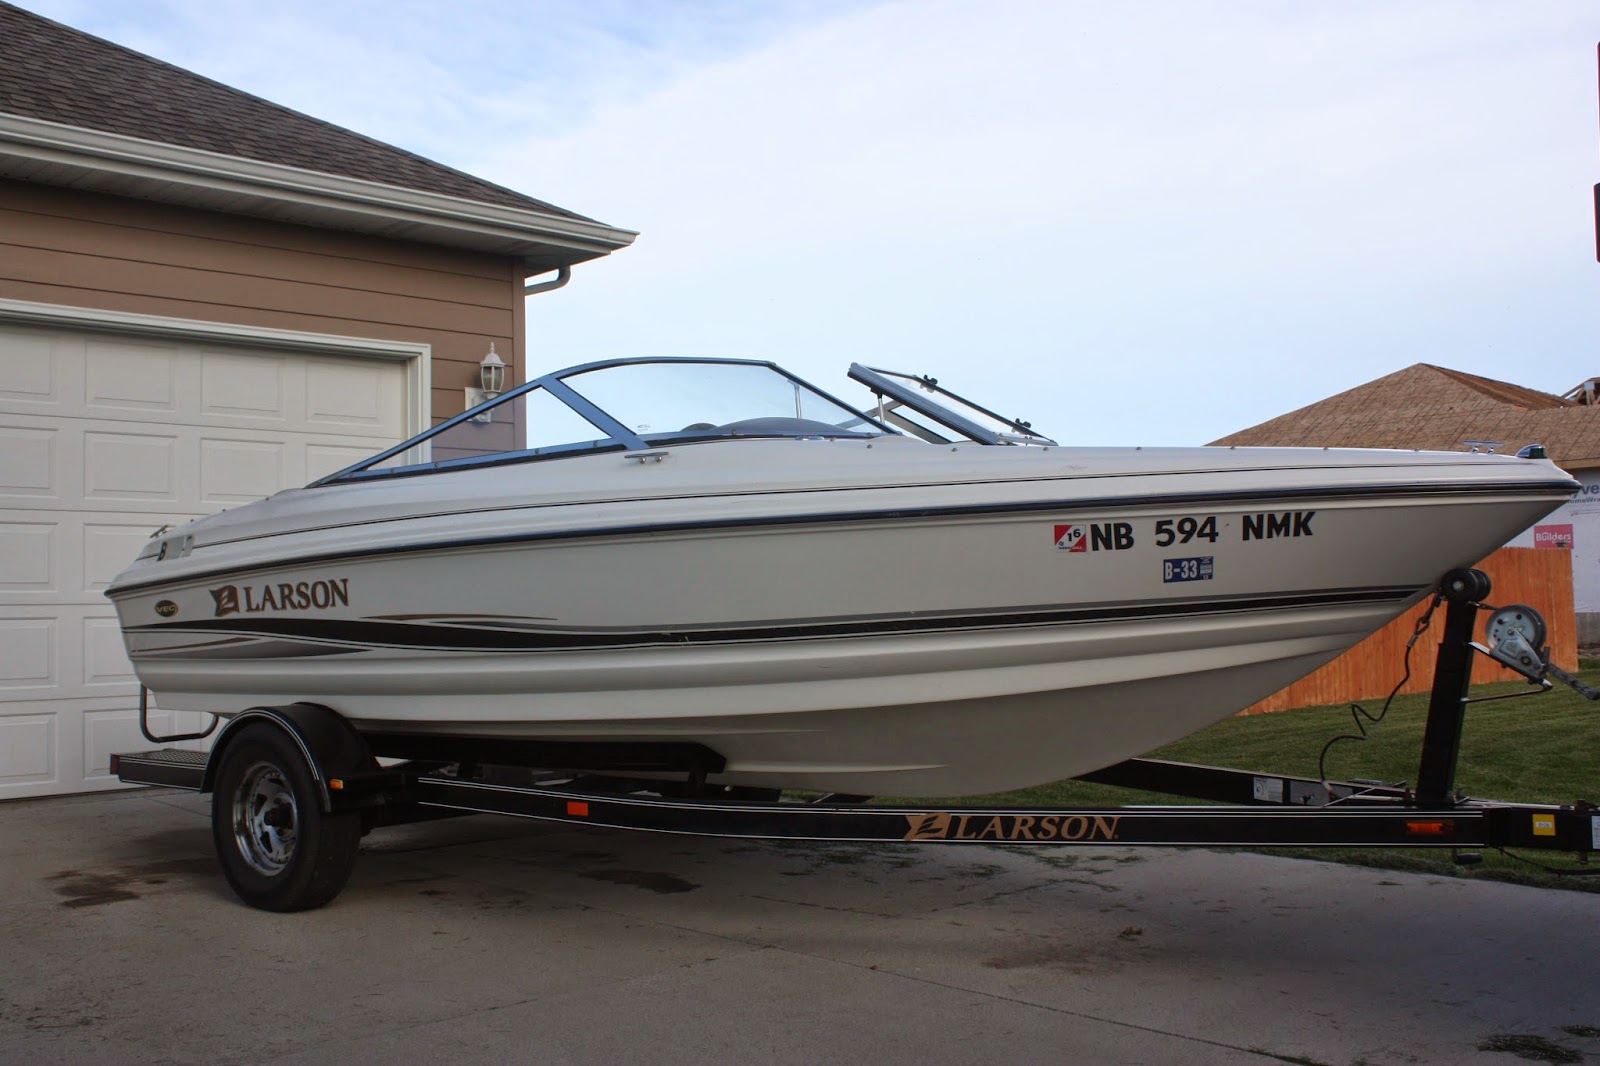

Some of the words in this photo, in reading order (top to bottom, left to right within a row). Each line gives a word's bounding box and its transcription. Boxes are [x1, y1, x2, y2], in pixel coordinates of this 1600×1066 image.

[1067, 528, 1081, 542] 16
[1091, 522, 1134, 551] NB
[1155, 516, 1219, 547] 594
[1242, 511, 1316, 541] NMK
[1536, 532, 1572, 541] Builders
[1164, 560, 1198, 580] B-33
[244, 578, 349, 612] LARSON
[953, 816, 1121, 840] LARSON
